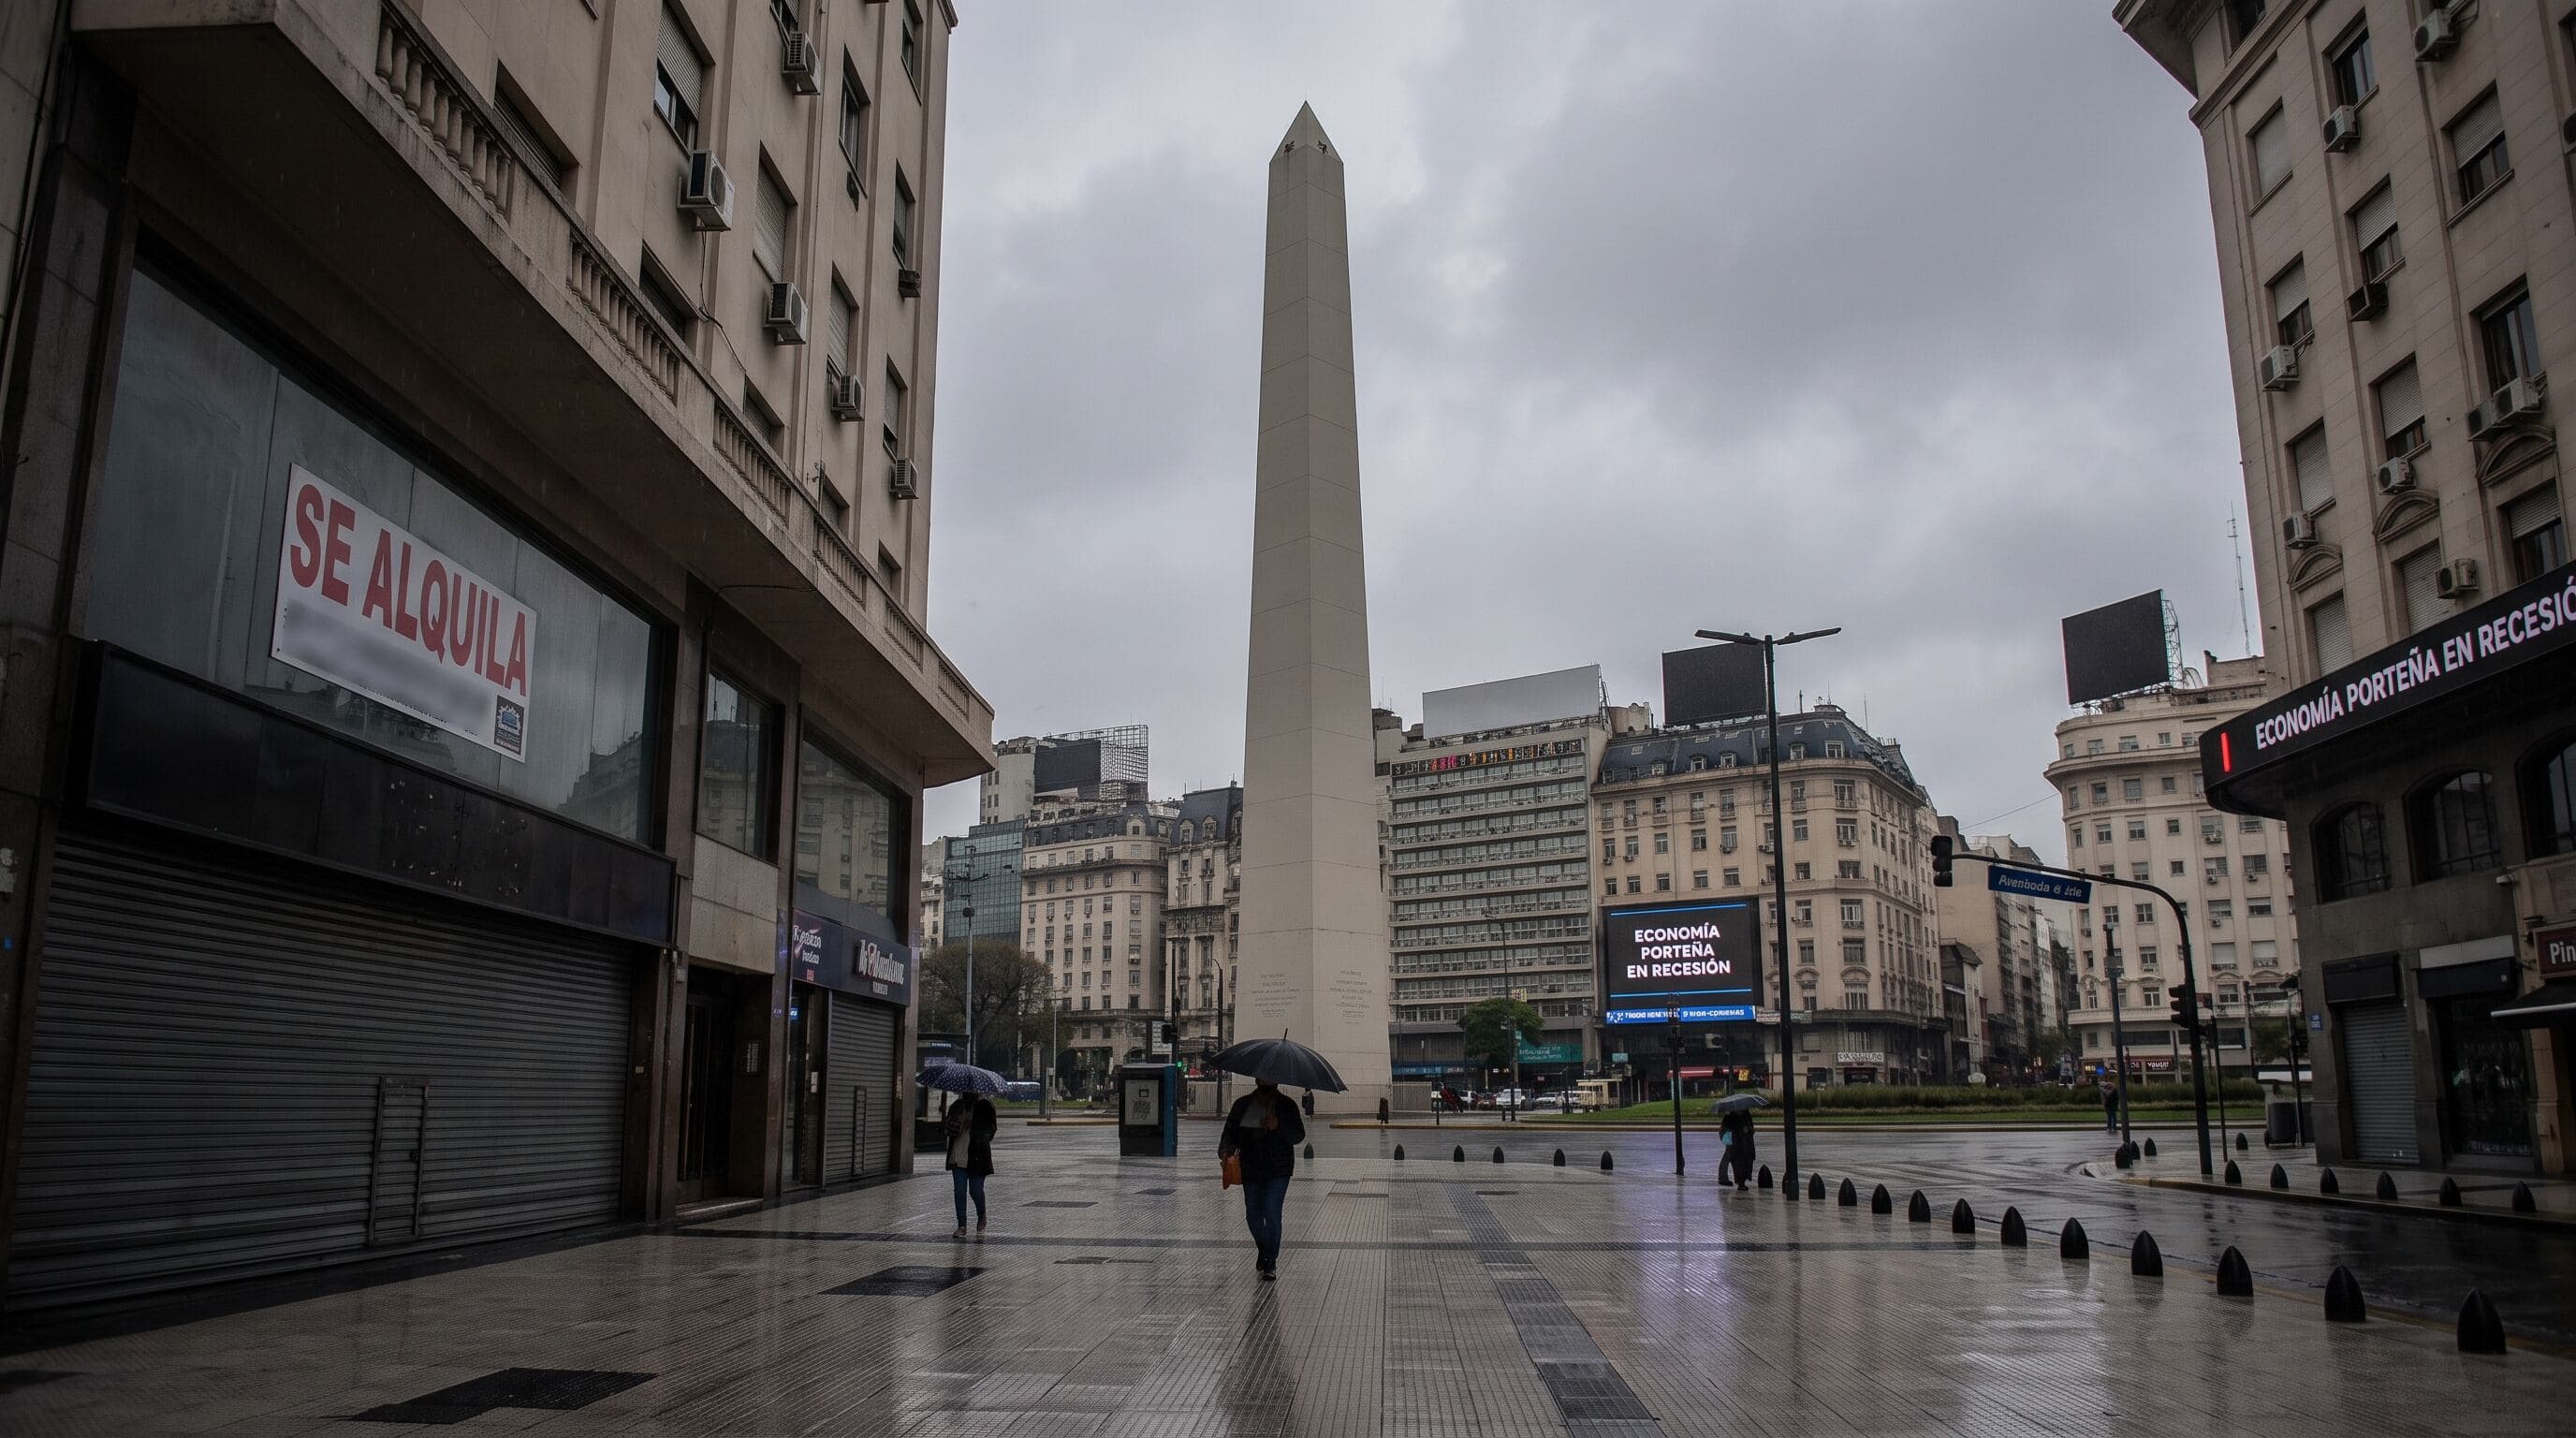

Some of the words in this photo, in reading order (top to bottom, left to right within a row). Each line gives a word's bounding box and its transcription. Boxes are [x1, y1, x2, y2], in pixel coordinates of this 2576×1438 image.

[290, 484, 356, 607] SE
[362, 528, 527, 697] ALQUILA
[2255, 685, 2344, 750] ECONOMÍA
[2347, 646, 2440, 712] PORTEÑA
[2443, 632, 2474, 672] EN
[1634, 922, 1720, 943] ECONOMÍA
[1641, 941, 1715, 960] PORTEÑA
[1627, 965, 1648, 978] EN
[1652, 959, 1731, 977] RECESIÓN
